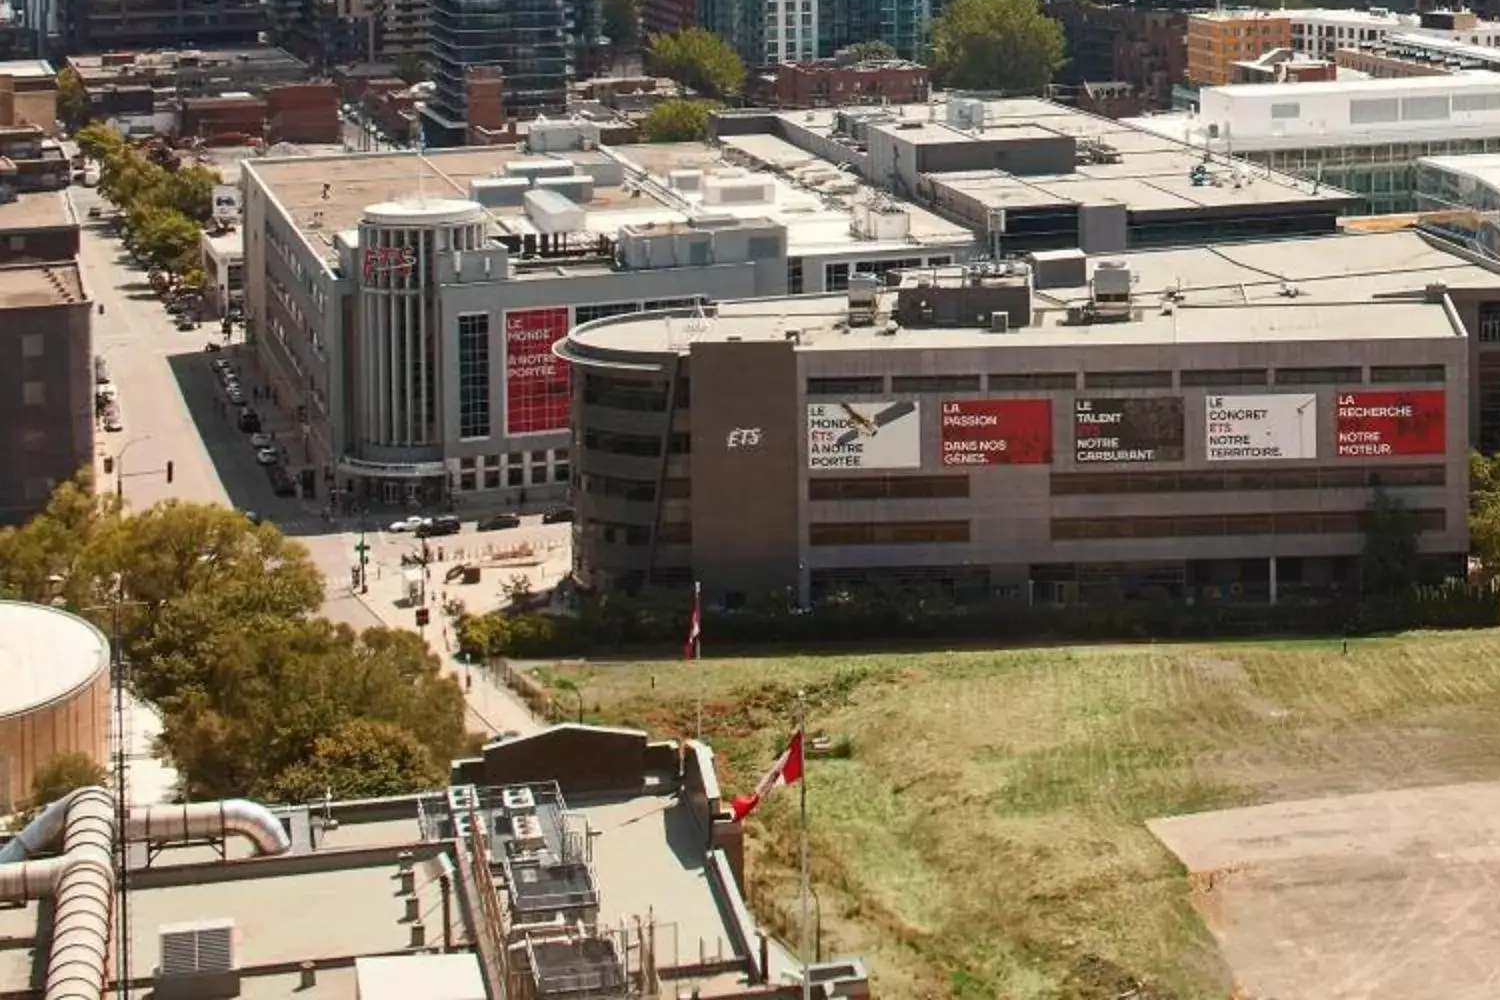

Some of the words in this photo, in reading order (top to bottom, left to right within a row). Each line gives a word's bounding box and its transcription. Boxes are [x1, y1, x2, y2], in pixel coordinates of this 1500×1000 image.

[507, 319, 523, 329] LE
[507, 330, 552, 343] MONDE
[1209, 397, 1223, 408] LE
[1338, 394, 1355, 405] LA
[943, 403, 960, 413] LA
[1076, 400, 1092, 411] LE
[1338, 405, 1412, 417] RECHERCHE
[811, 407, 825, 416] LE
[1209, 409, 1268, 420] CONCRET
[943, 415, 998, 426] PASSION
[1076, 413, 1122, 423] TALENT
[811, 419, 855, 429] MONDE
[1077, 437, 1119, 448] NOTRE
[1209, 435, 1250, 446] NOTRE
[1339, 431, 1381, 443] NOTRE
[822, 443, 864, 453] NOTRE
[943, 440, 978, 451] DANS
[979, 440, 1007, 451] NOS
